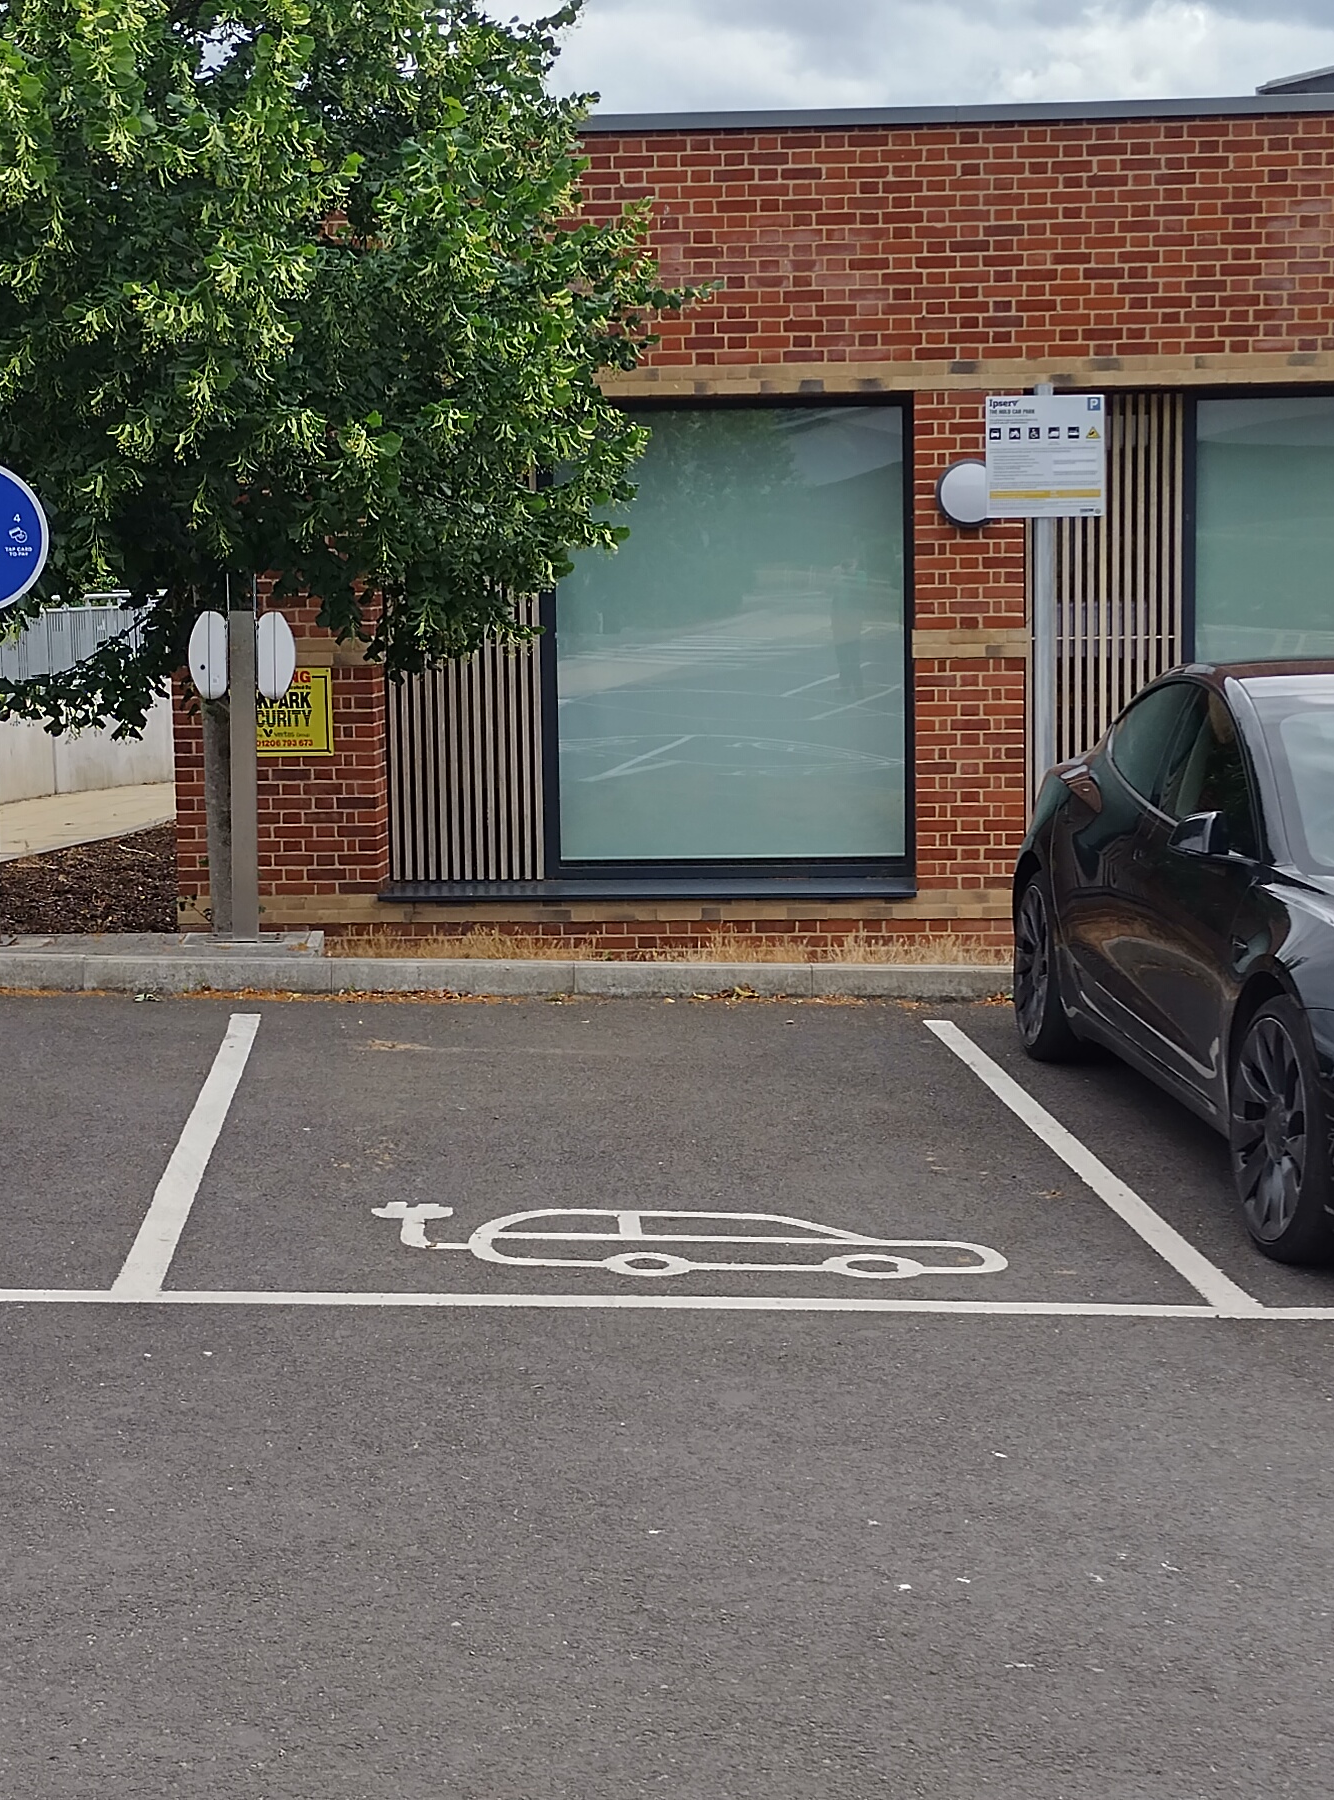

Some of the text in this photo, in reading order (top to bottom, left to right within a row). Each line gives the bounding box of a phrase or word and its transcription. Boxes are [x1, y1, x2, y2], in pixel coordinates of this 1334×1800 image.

[989, 399, 1019, 409] Ipserv
[13, 513, 21, 523] 4
[257, 692, 312, 709] KPARK
[257, 710, 312, 728] CURITY
